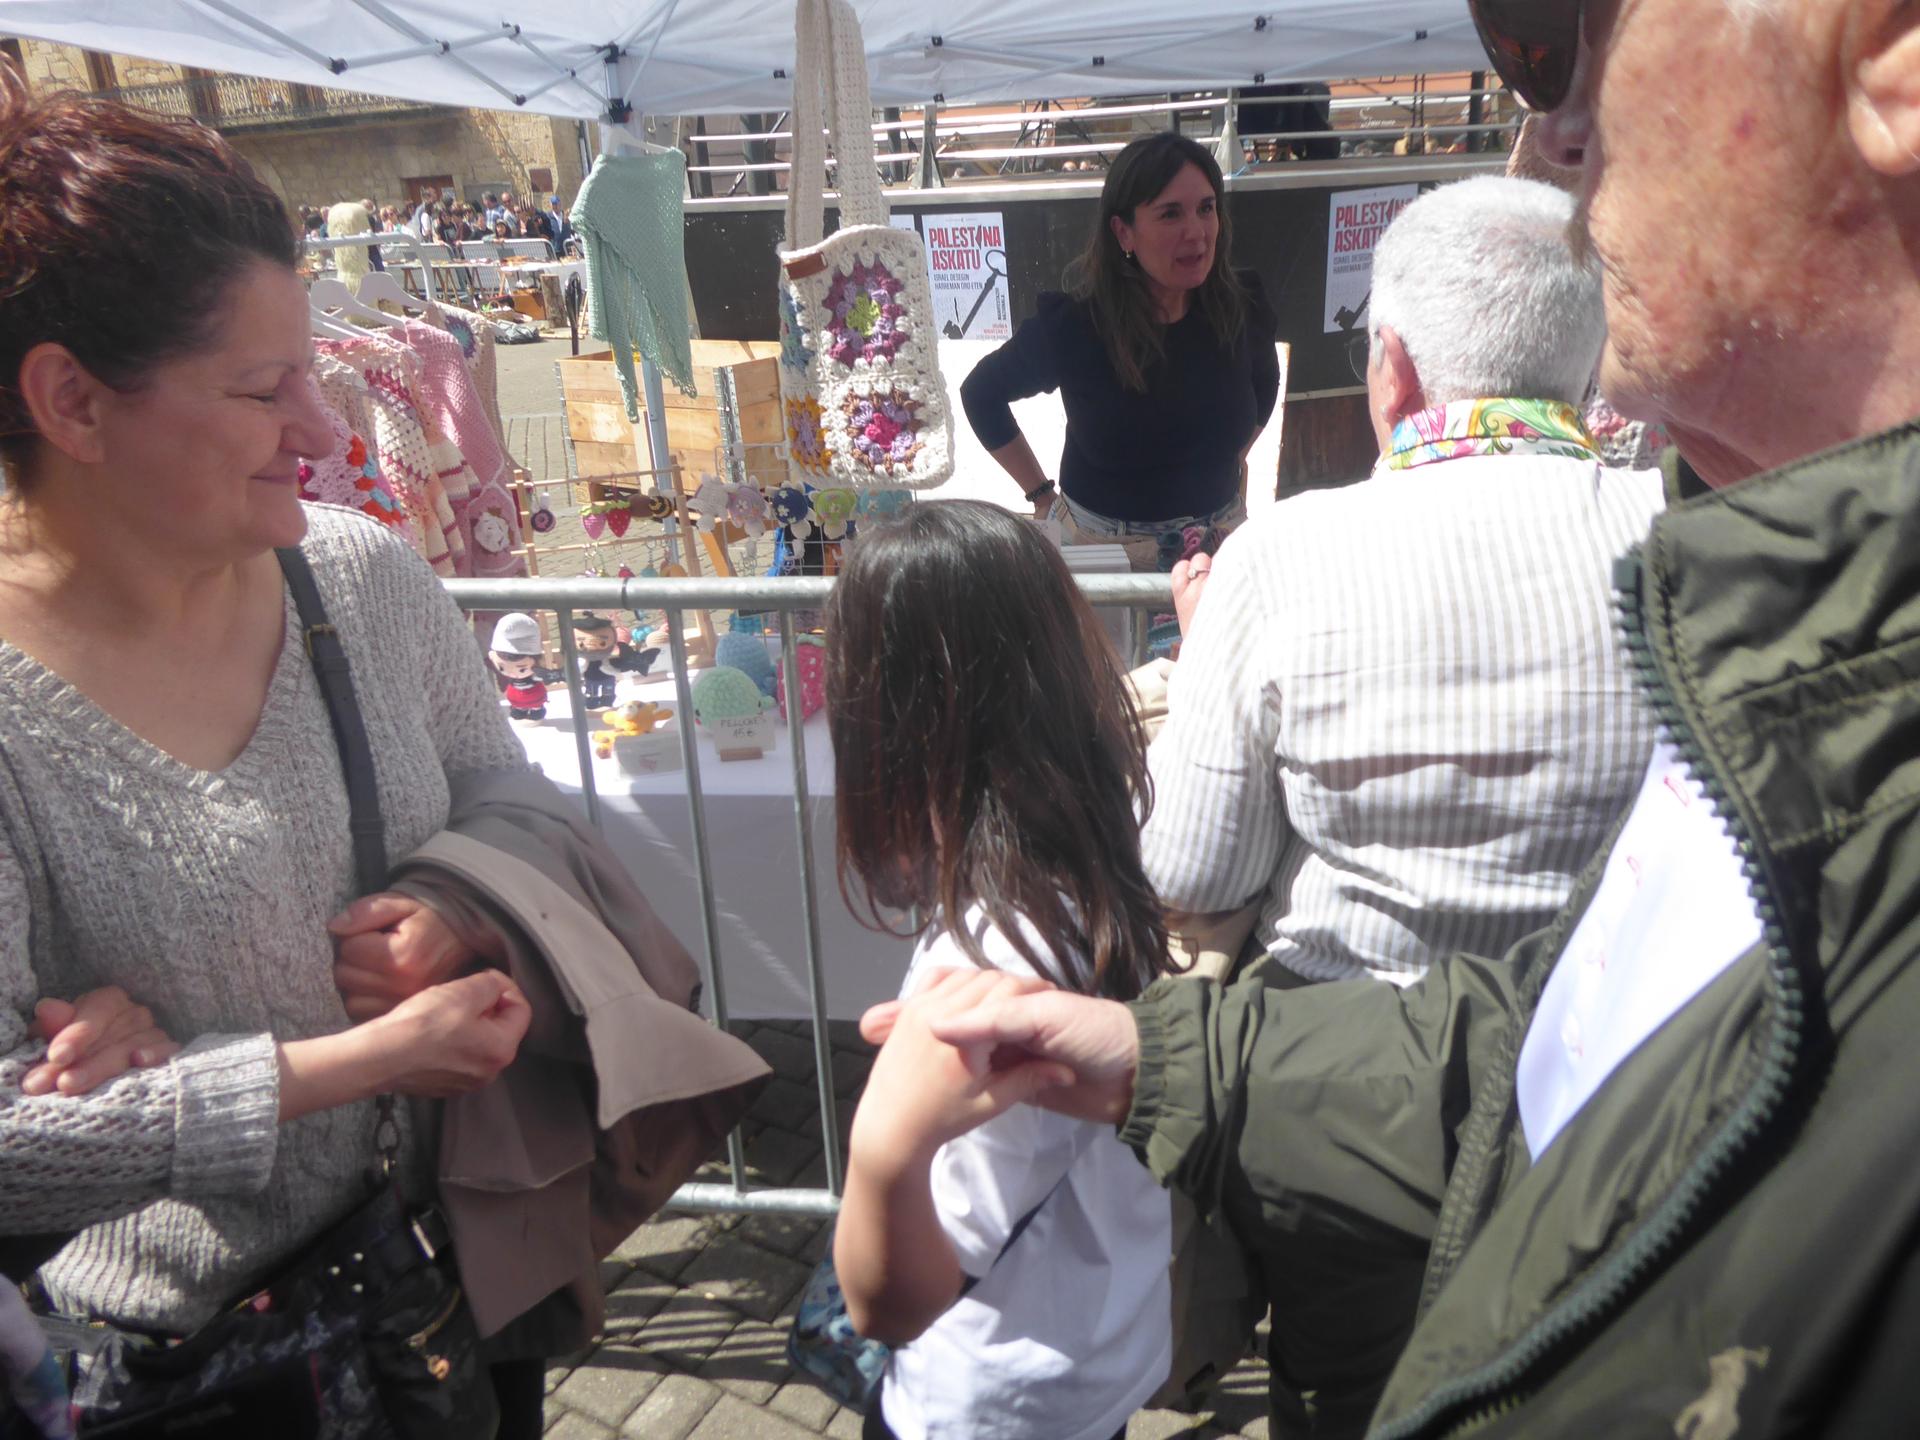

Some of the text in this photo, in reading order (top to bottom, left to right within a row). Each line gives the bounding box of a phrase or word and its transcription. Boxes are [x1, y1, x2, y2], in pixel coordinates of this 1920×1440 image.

[1335, 198, 1413, 229] PALESTIN
[928, 225, 1002, 249] PALESTINA
[932, 248, 981, 270] ASKATU
